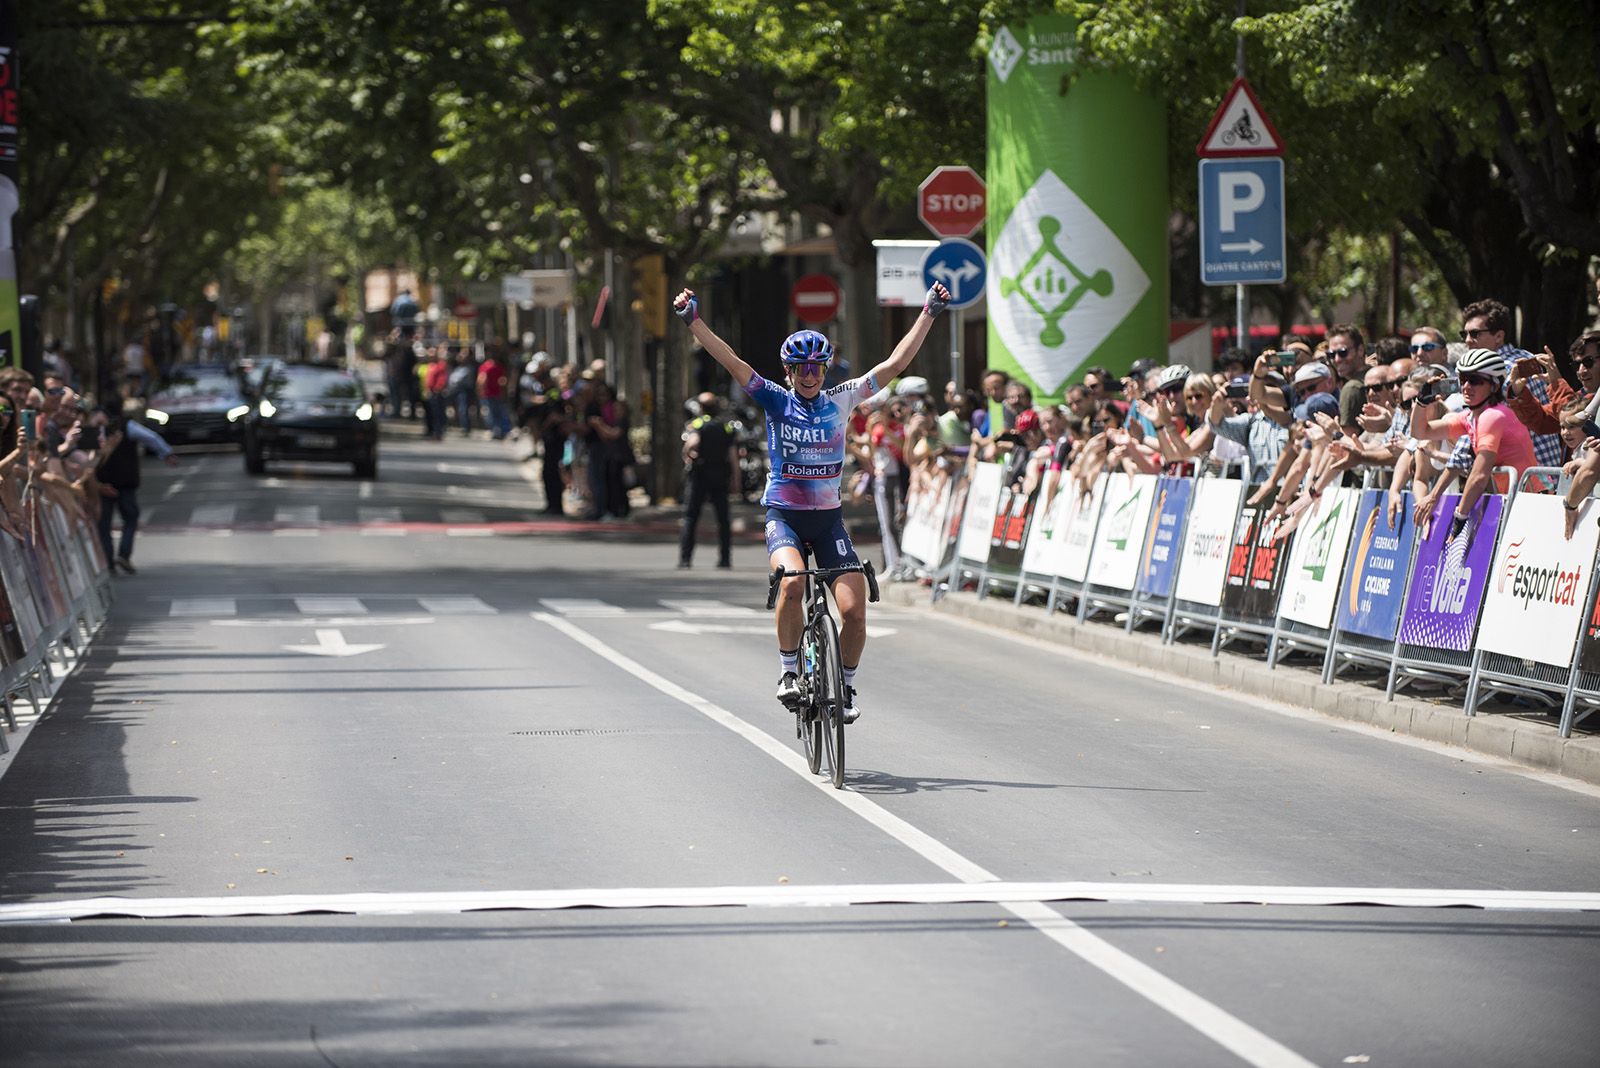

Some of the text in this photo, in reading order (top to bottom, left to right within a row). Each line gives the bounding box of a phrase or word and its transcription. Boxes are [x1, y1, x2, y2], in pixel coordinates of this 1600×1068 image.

[927, 193, 984, 213] STOP
[1219, 171, 1266, 233] P
[780, 422, 828, 443] ISRAEL
[787, 464, 827, 476] Roland
[1374, 535, 1399, 551] FEDERACIÓ
[1252, 547, 1278, 581] RIDE
[1369, 555, 1395, 571] CATALANA
[1364, 575, 1391, 596] CICLISME
[1512, 561, 1581, 611] esportcat
